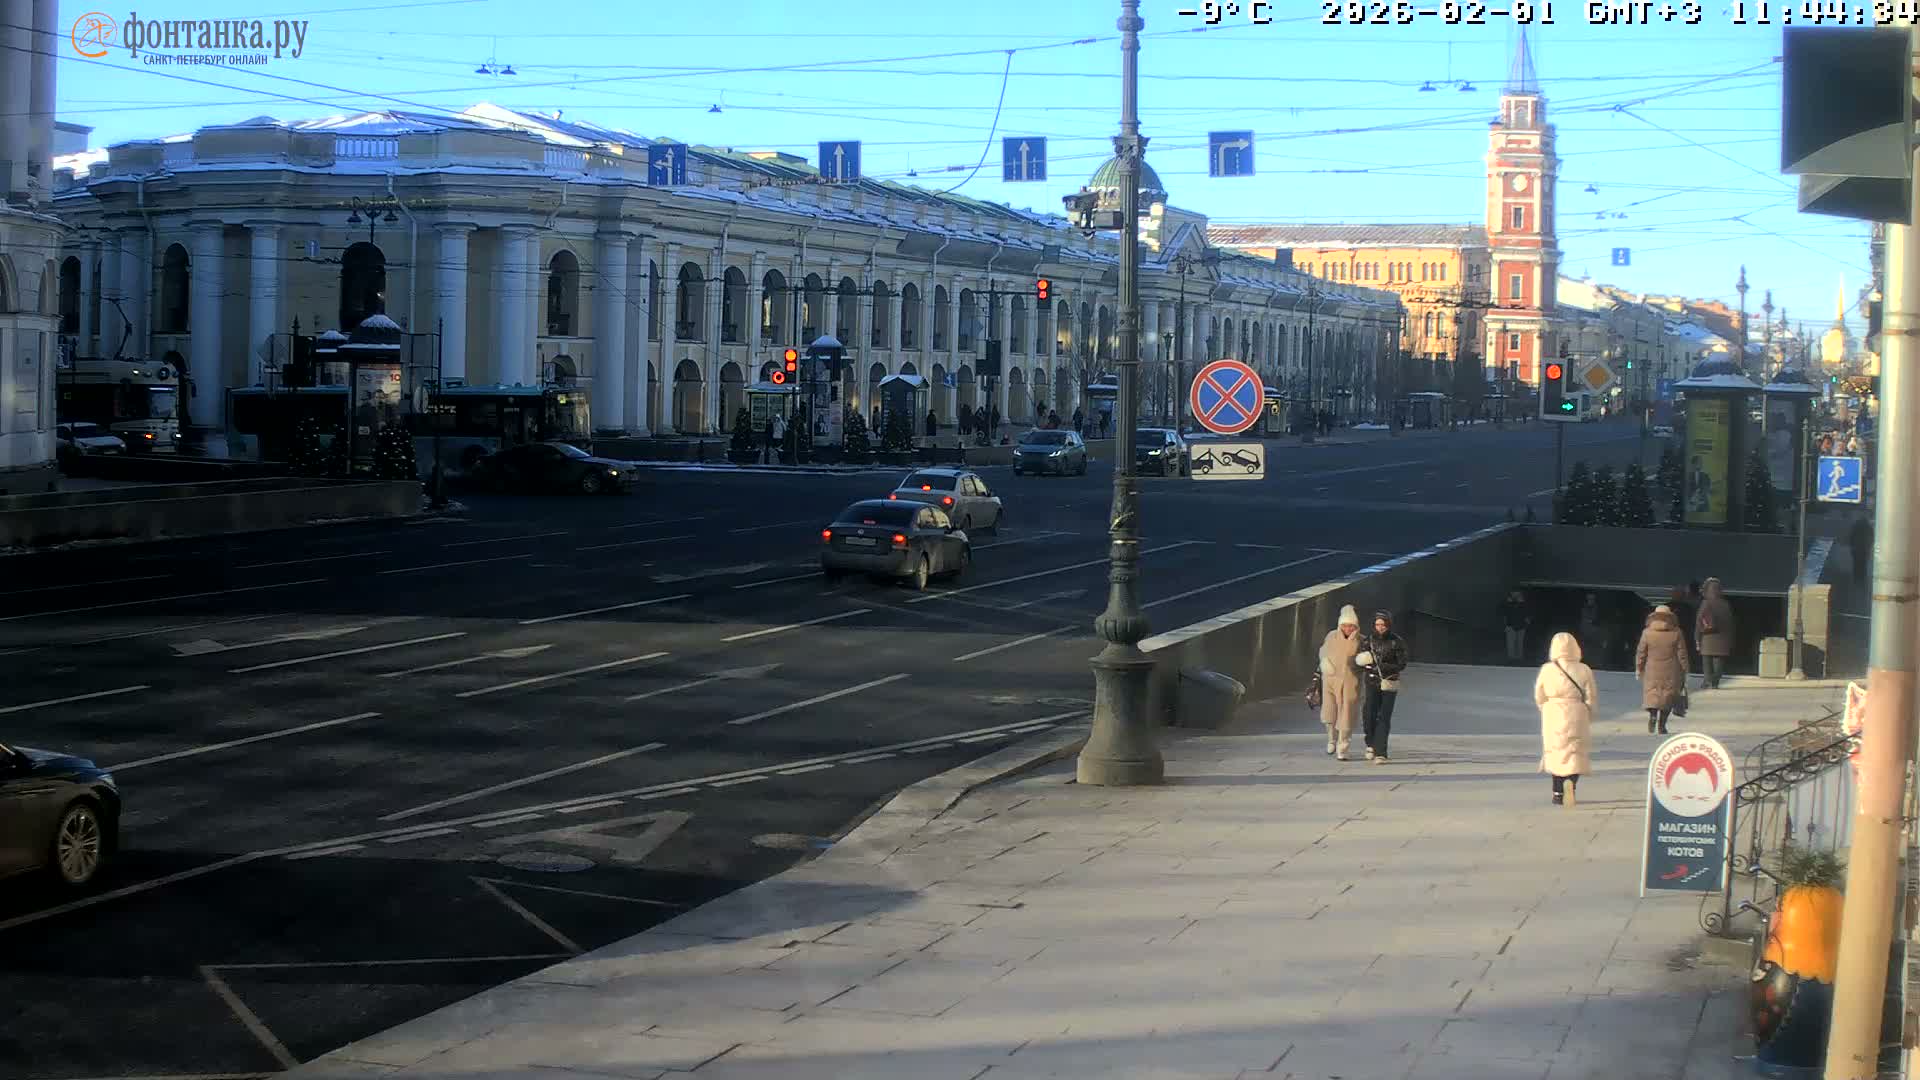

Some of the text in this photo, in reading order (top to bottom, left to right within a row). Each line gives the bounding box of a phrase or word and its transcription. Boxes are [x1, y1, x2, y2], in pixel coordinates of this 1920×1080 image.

[1656, 743, 1727, 787] ЧУДЕСНОЕ РЯДОМ
[1659, 822, 1717, 834] МАГАЗИН
[1667, 846, 1704, 858] КОТОВ
